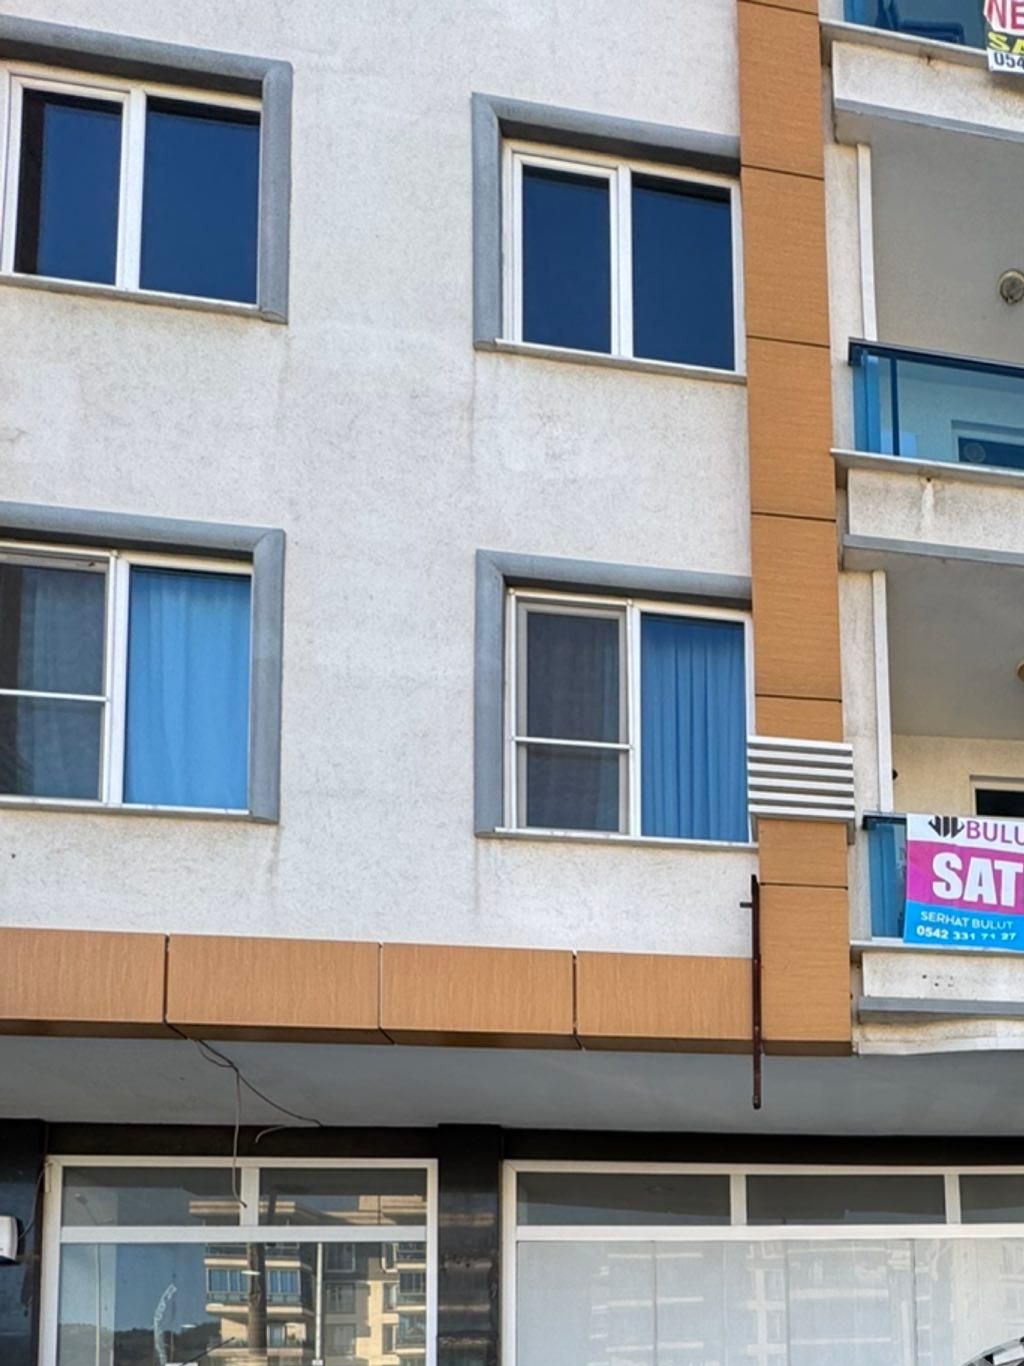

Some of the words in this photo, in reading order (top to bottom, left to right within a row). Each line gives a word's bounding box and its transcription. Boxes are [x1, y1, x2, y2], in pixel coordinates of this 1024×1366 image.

[921, 910, 970, 928] SERHAT
[972, 918, 1013, 930] BULUT
[916, 925, 949, 940] 0542
